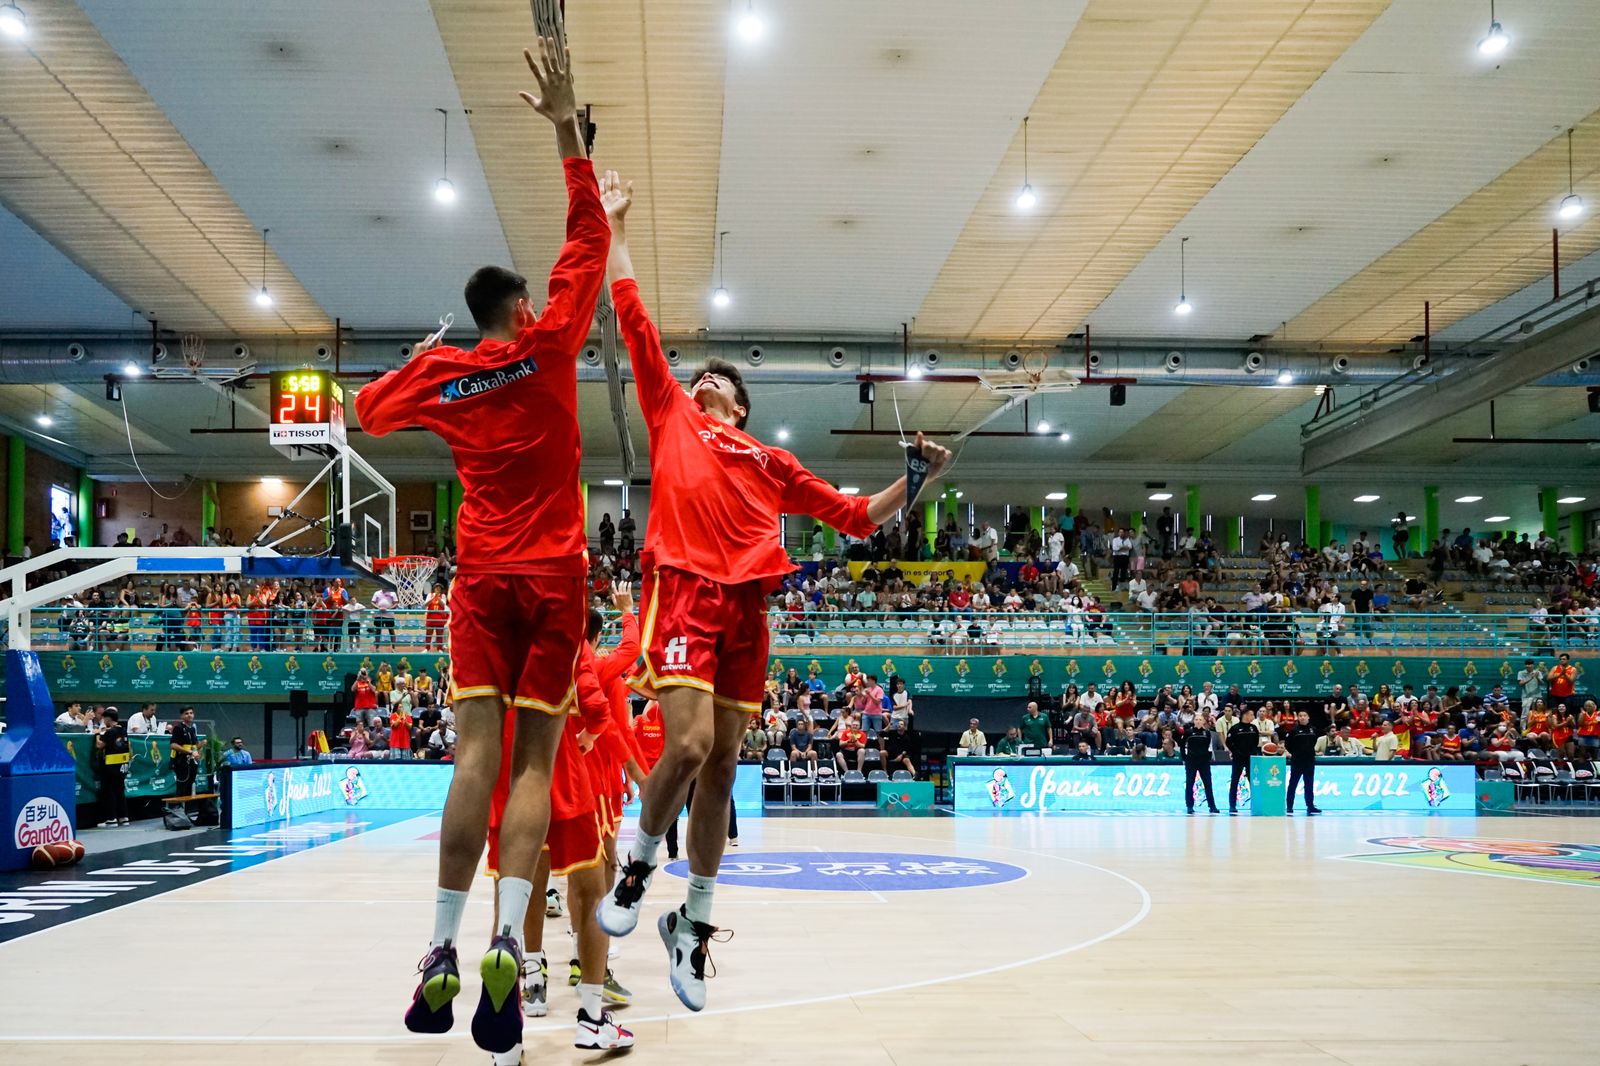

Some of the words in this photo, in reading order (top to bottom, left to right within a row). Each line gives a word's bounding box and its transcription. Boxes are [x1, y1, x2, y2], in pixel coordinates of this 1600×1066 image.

[458, 362, 533, 395] CaixaBank
[280, 394, 320, 424] 24
[288, 429, 326, 438] TISSOT
[1020, 766, 1103, 811] Spain
[1112, 772, 1172, 797] 2022
[1351, 772, 1410, 797] 2022
[26, 804, 58, 823] 百岁山
